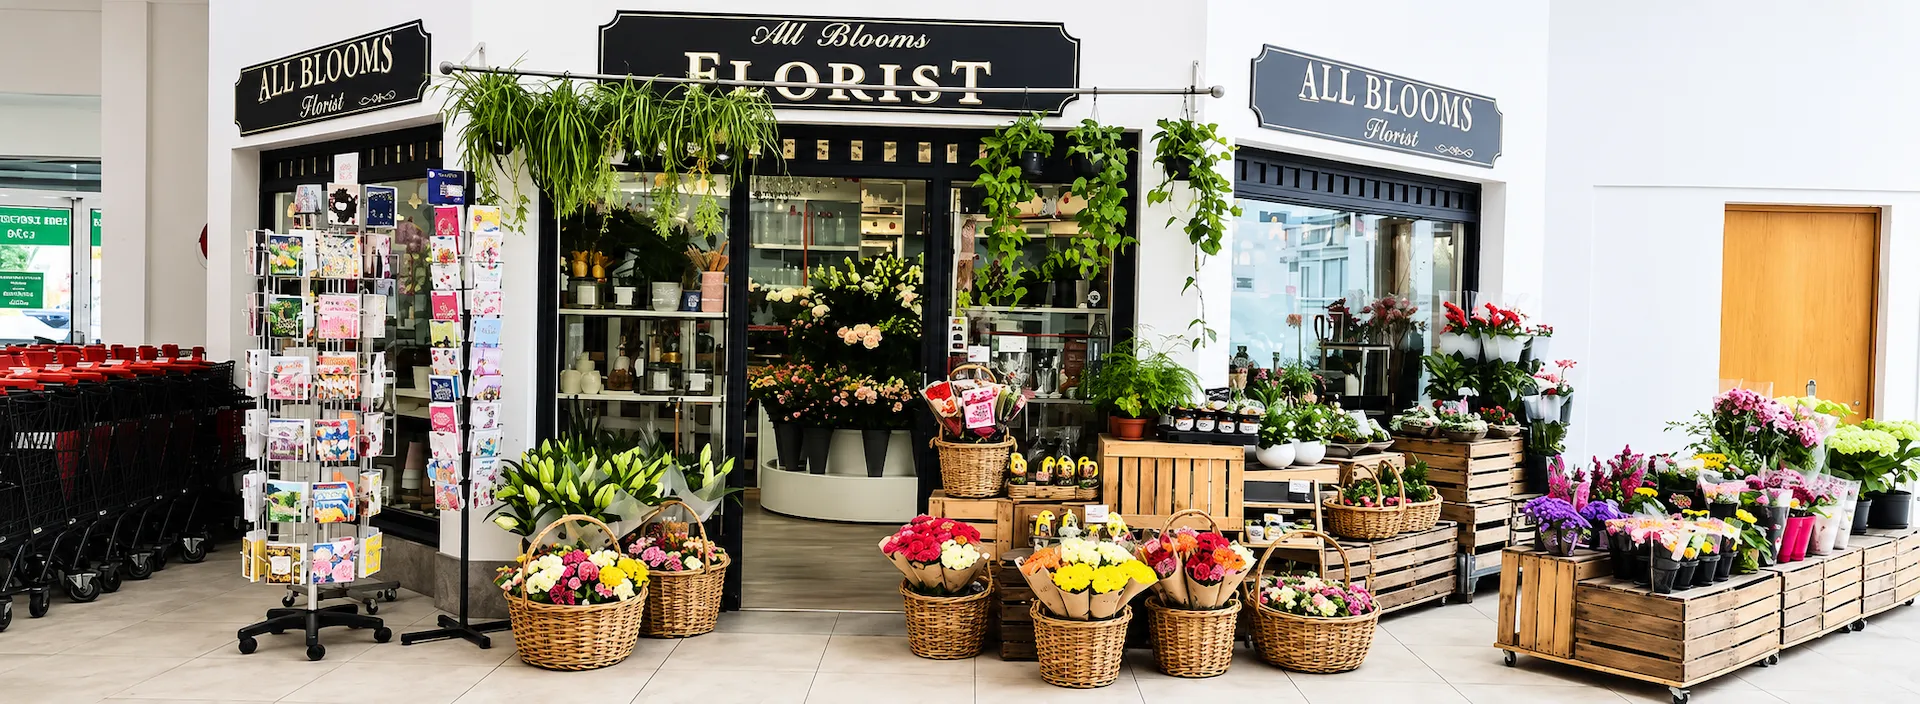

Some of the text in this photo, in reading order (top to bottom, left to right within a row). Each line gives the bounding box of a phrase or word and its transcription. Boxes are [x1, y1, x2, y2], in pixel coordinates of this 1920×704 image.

[750, 20, 931, 49] All Blooms
[258, 33, 394, 103] ALL BLOOMS
[684, 51, 992, 105] FLORIST
[299, 91, 345, 118] Florist
[1298, 60, 1473, 132] ALL BLOOMS
[1363, 117, 1419, 147] Florist
